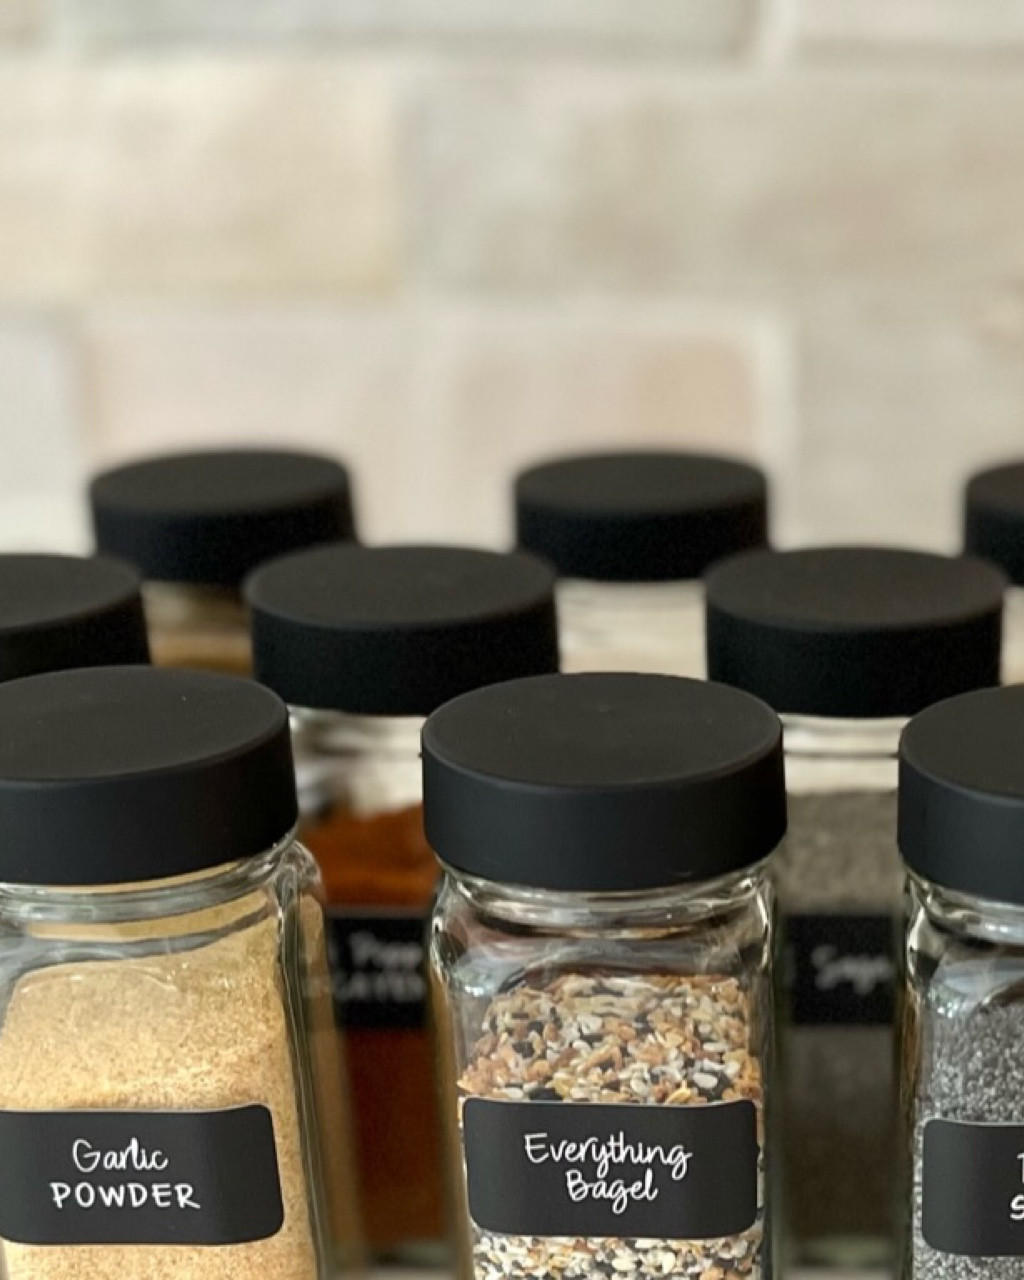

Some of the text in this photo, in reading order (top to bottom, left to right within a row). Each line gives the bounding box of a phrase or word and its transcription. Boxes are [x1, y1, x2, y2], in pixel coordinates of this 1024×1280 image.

[72, 1137, 169, 1173] Garlic
[523, 1130, 693, 1181] Everything
[49, 1181, 202, 1209] POWDER
[565, 1168, 659, 1214] Bagel
